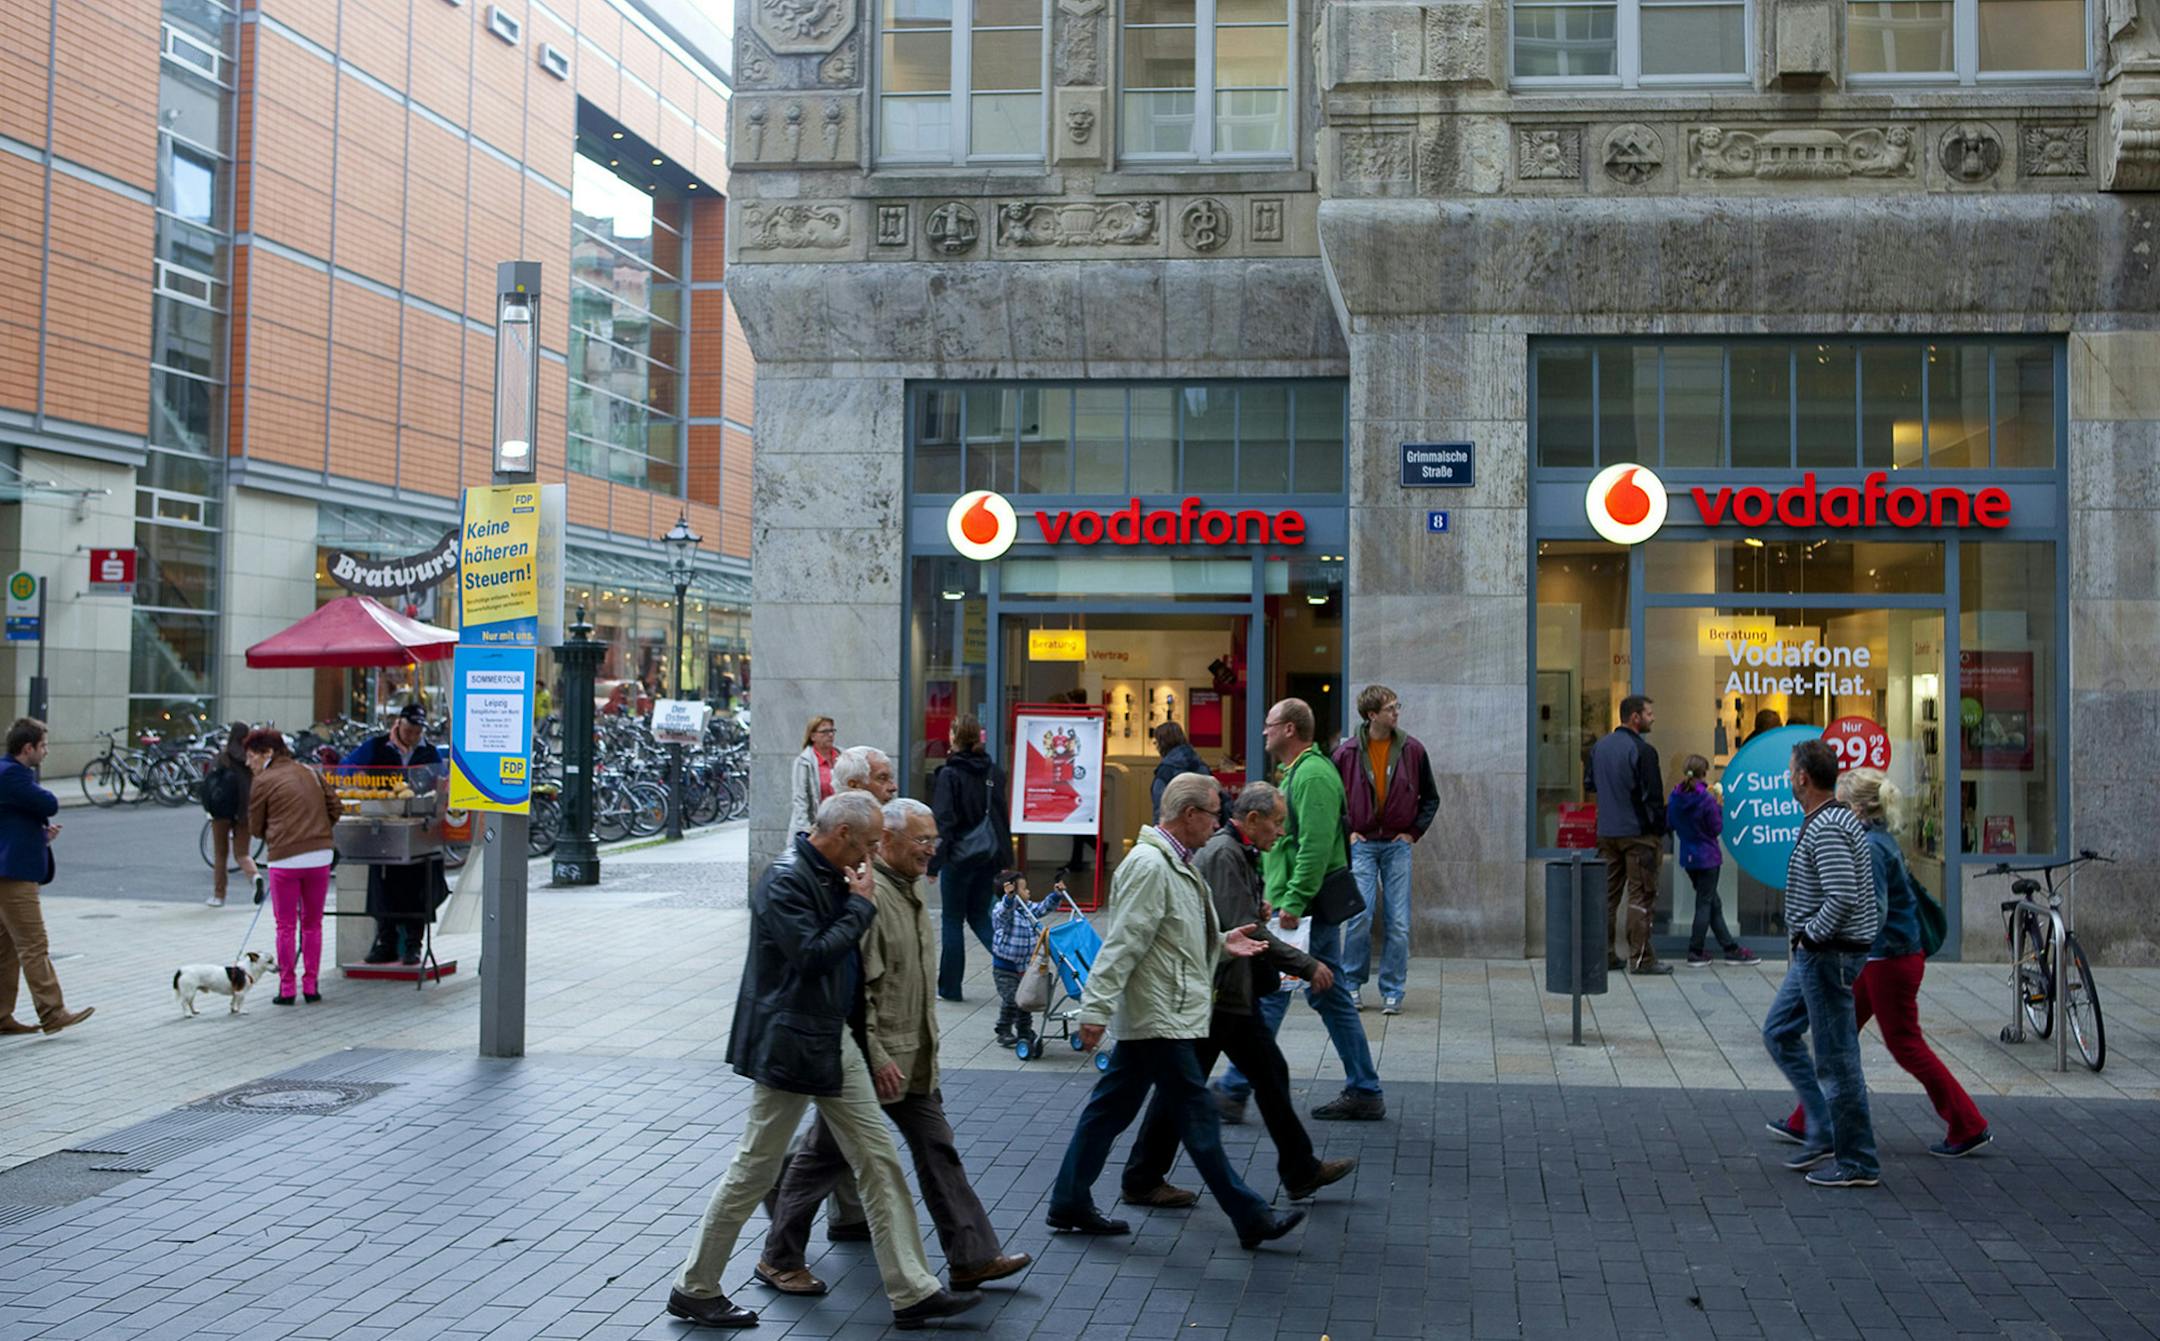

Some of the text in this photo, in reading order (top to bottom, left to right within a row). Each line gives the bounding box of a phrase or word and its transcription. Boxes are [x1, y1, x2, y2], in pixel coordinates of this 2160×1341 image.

[1406, 450, 1468, 463] Grimmaische
[1422, 465, 1453, 478] Straße
[515, 494, 533, 505] FDP
[1691, 472, 2012, 529] vodafone
[1035, 497, 1305, 545] vodafone
[1432, 514, 1444, 529] 8
[466, 519, 510, 540] Keine
[464, 542, 528, 564] höheren
[332, 538, 459, 588] Bratwurst
[464, 563, 531, 590] Steuern!
[1709, 629, 1768, 643] Beratung
[1032, 639, 1077, 651] Beratung
[1724, 639, 1871, 668] Vodafone
[471, 674, 521, 684] SOMMERTOUR
[1724, 671, 1872, 696] Allnet-Flat.
[484, 699, 508, 709] Leipzig
[1842, 721, 1863, 733] Nur
[503, 761, 524, 775] FDP
